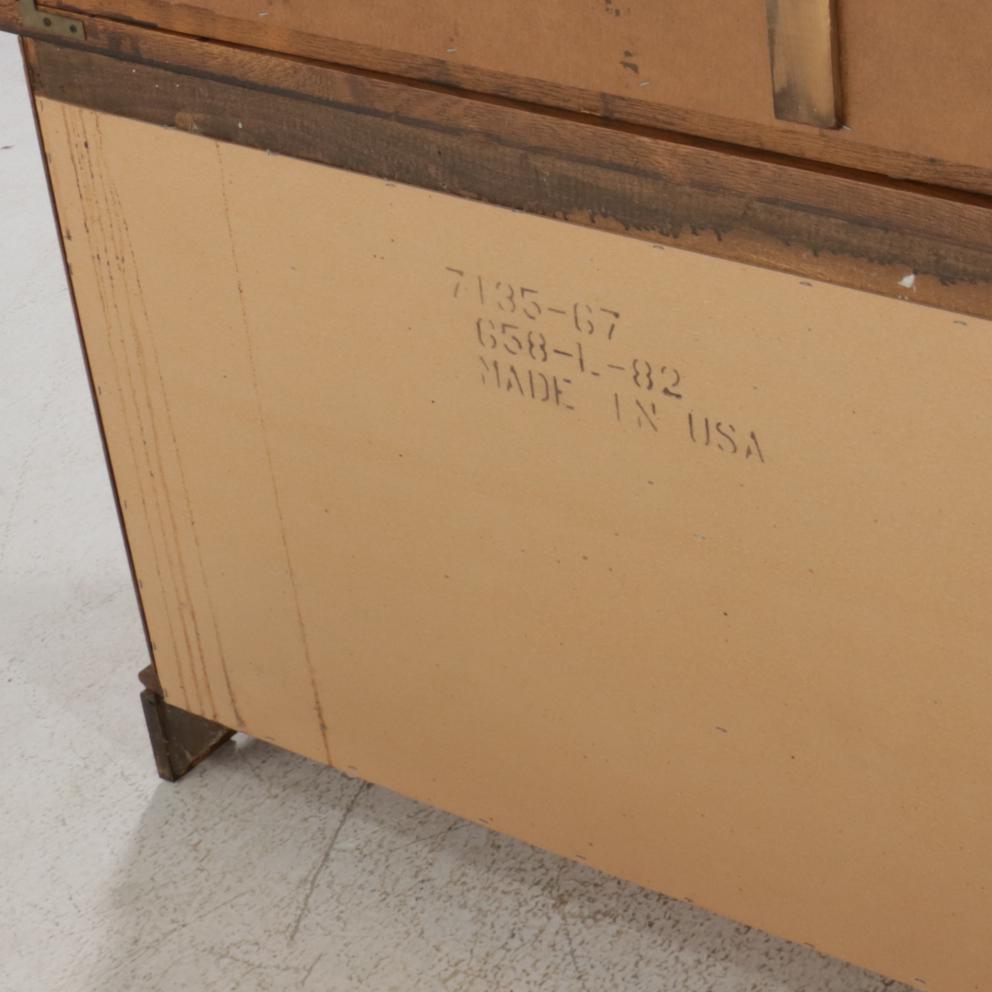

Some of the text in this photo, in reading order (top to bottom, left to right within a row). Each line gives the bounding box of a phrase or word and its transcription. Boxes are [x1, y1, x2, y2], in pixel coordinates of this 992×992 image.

[444, 266, 621, 340] 7135-67
[479, 355, 765, 463] MADE IN USA
